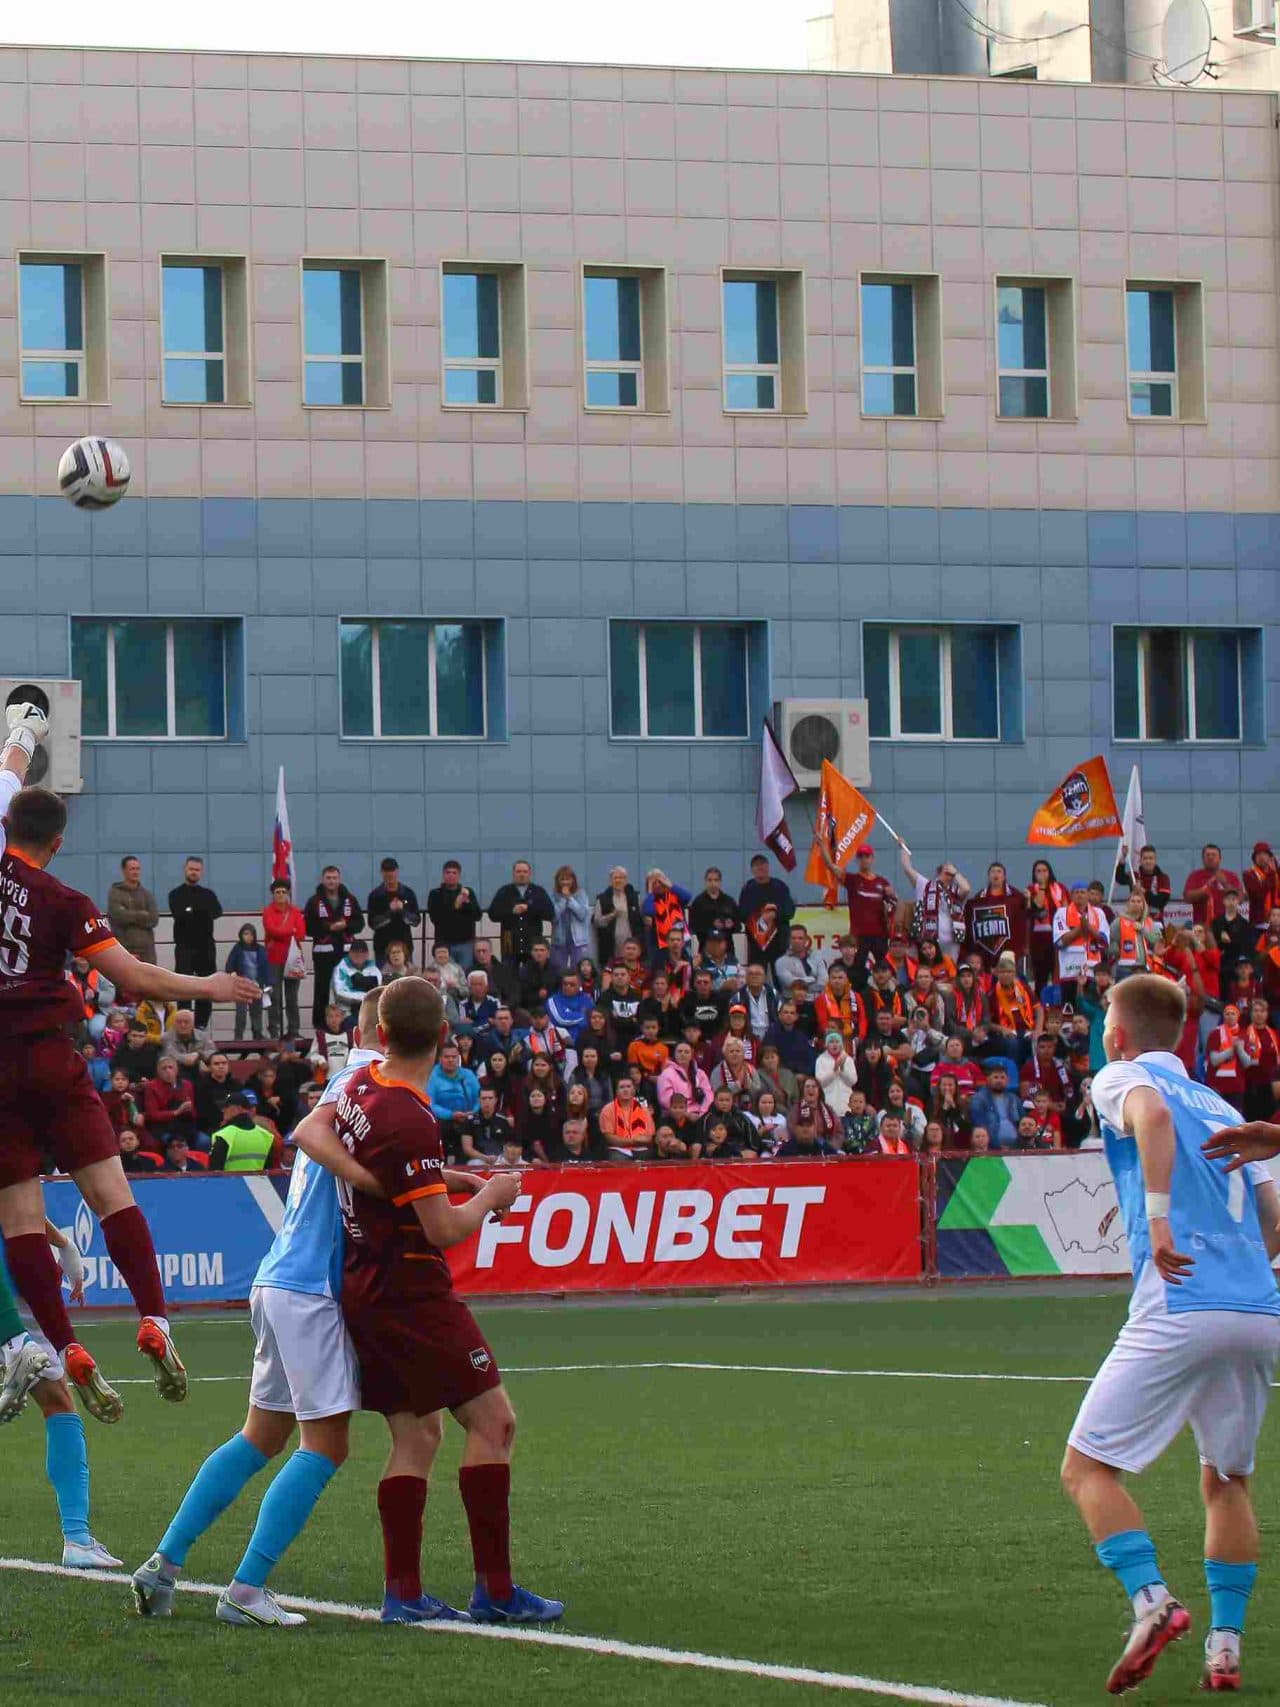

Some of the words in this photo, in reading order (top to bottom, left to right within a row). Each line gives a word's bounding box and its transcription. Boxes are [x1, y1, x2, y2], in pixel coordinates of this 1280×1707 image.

[975, 918, 1007, 938] ТЕМП
[475, 1186, 826, 1269] FONBET
[99, 1252, 225, 1290] ГАПРОМ
